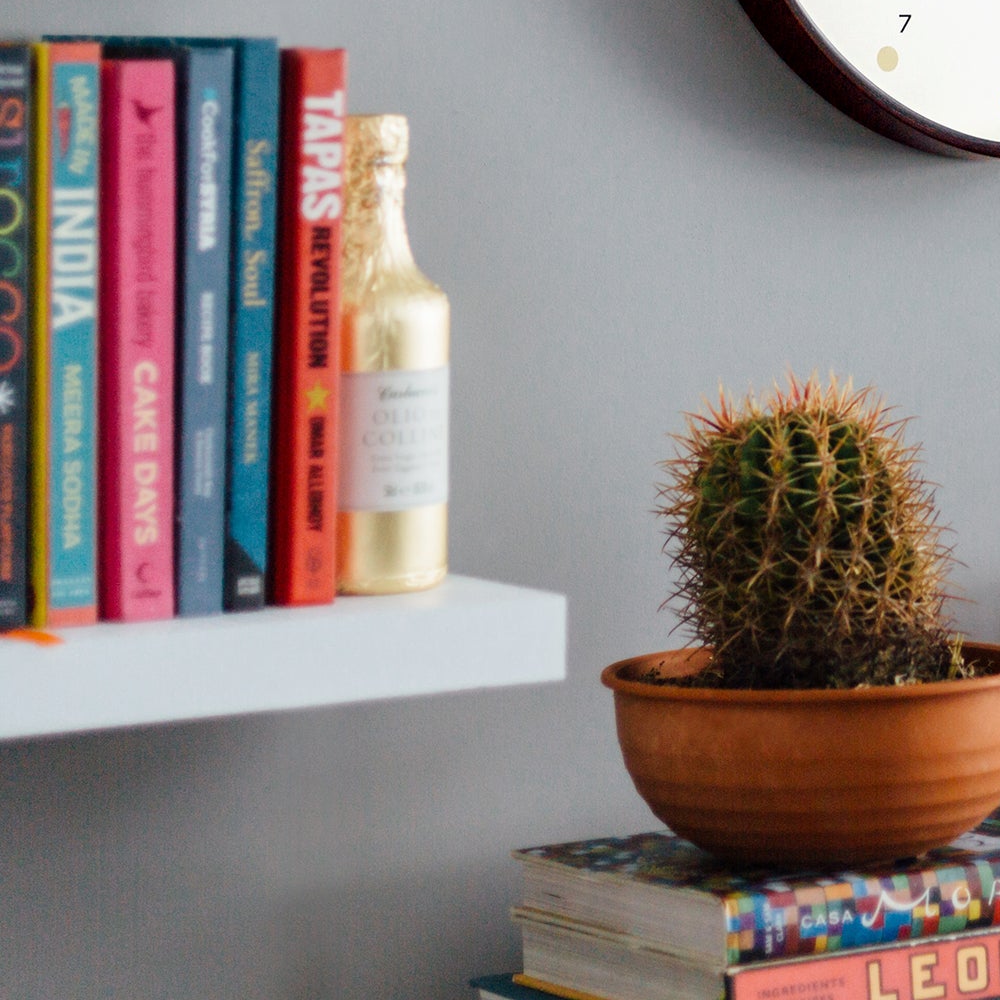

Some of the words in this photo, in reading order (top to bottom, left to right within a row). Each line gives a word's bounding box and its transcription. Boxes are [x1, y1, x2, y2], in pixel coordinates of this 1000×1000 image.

[899, 15, 911, 33] 7
[302, 89, 345, 221] TAPAS
[52, 188, 95, 329] INDIA
[243, 249, 266, 307] Soul
[308, 226, 332, 369] REVOLUTION
[62, 364, 83, 454] MEERA
[133, 360, 158, 453] CAKE
[62, 461, 82, 549] SODHA
[133, 462, 158, 546] DAYS
[801, 910, 854, 929] CASA
[757, 977, 845, 999] INGREDIENTS
